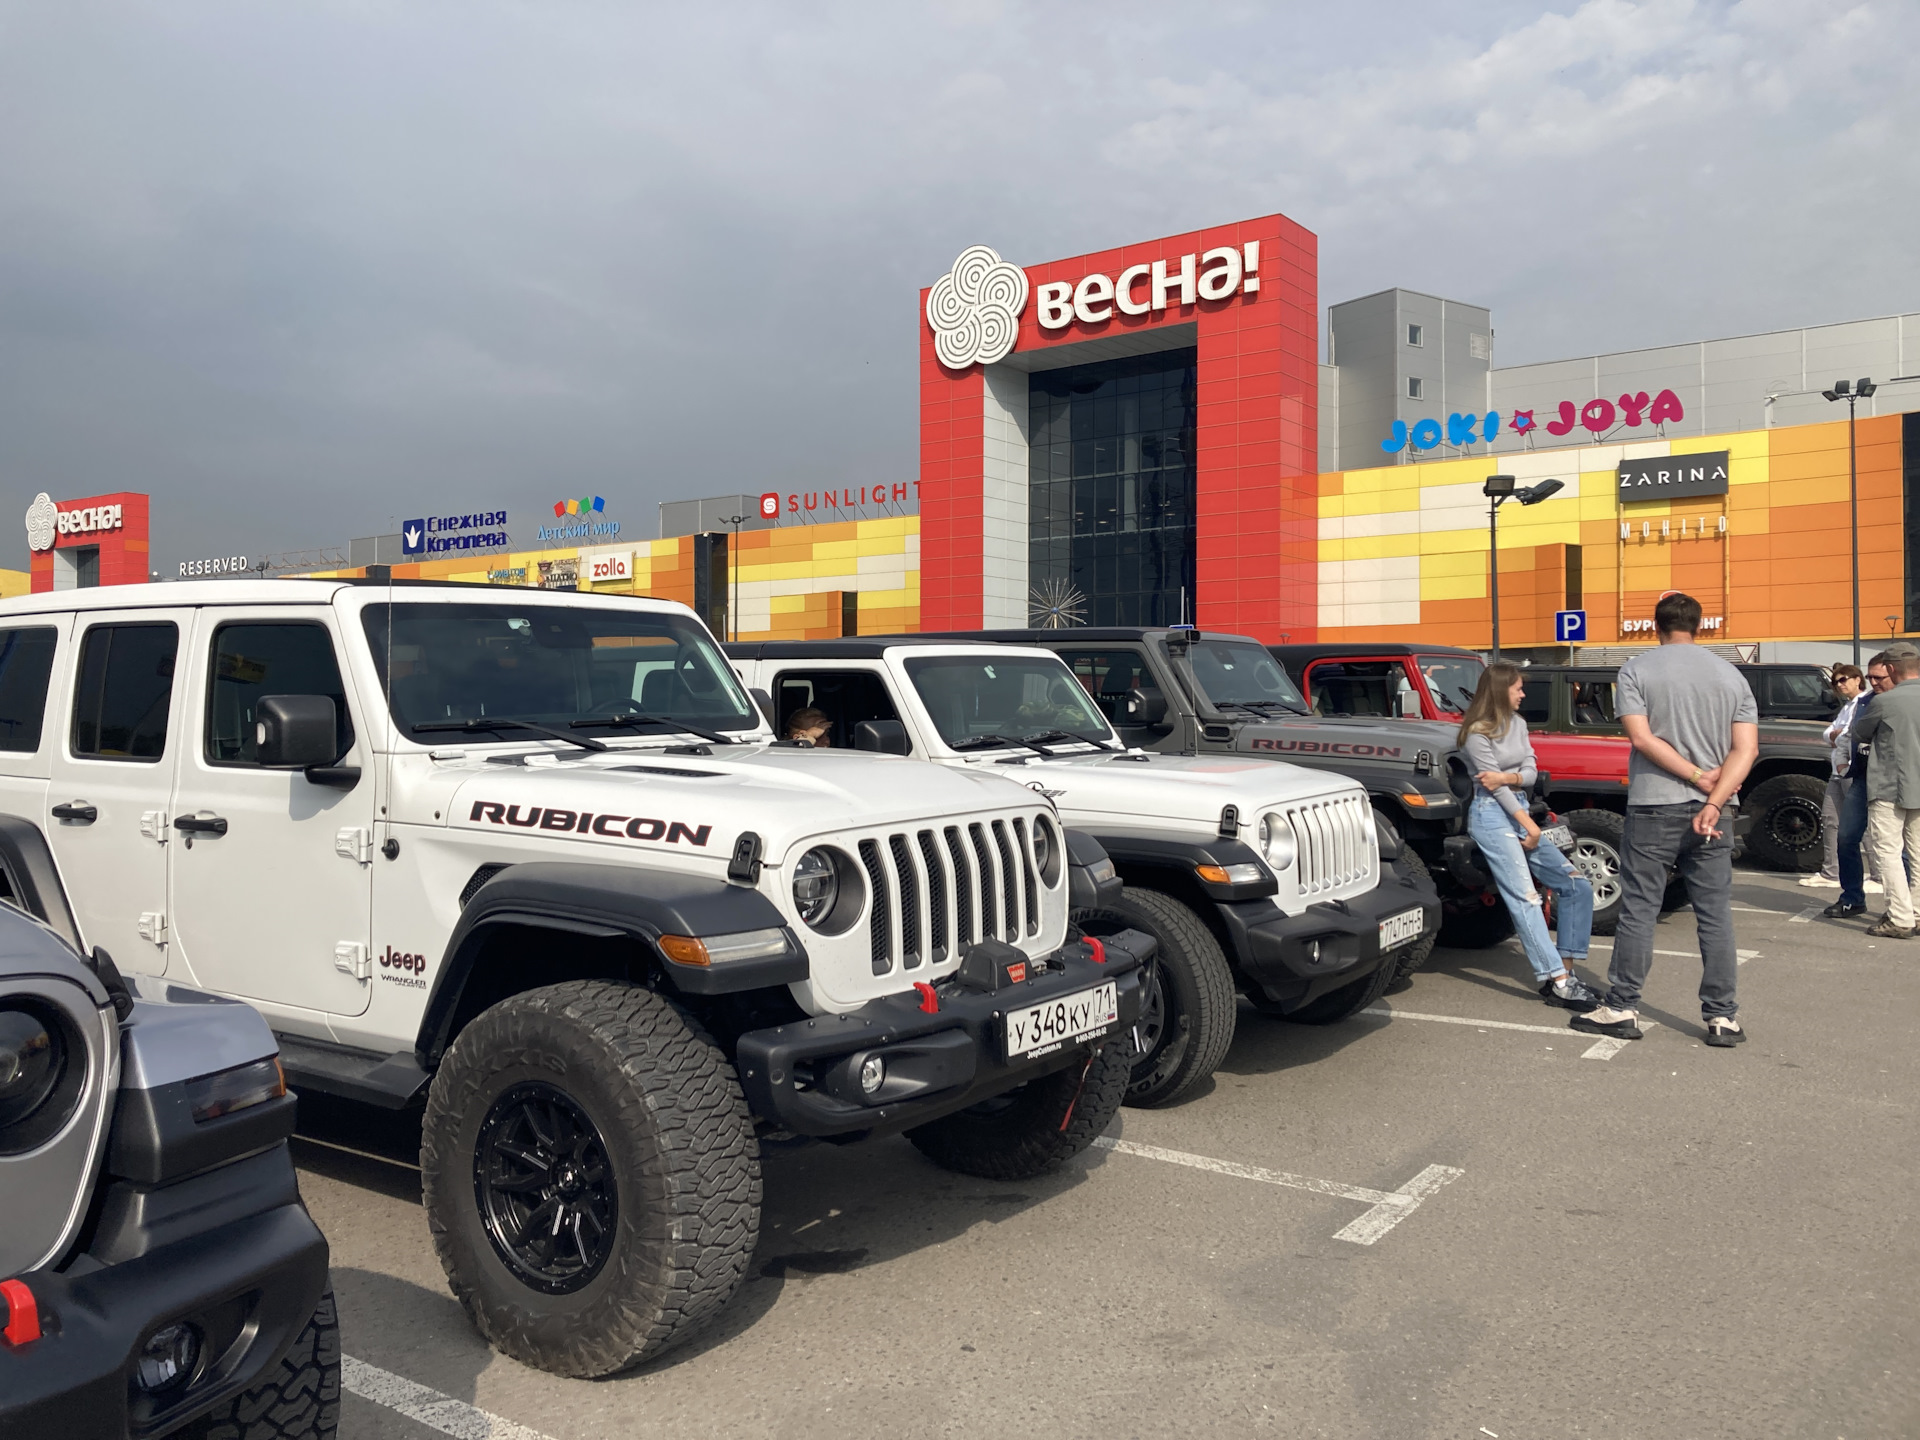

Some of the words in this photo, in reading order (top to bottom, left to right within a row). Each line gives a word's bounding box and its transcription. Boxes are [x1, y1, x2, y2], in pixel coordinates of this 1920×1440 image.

[1381, 410, 1500, 453] JOKI
[1547, 389, 1684, 436] JOYA
[1620, 465, 1726, 488] ZARINA
[427, 510, 507, 532] Снежная
[536, 521, 590, 542] Детский
[593, 521, 620, 539] мир
[1620, 515, 1726, 539] MOHITO
[427, 531, 507, 553] Королева
[179, 555, 248, 576] RESERVED
[593, 557, 625, 577] zolla
[1563, 614, 1581, 639] P
[1252, 739, 1401, 757] RUBICON
[469, 800, 713, 847] RUBICON
[379, 945, 426, 976] Jeep
[381, 974, 427, 986] WRANGLER
[1095, 1011, 1108, 1024] RUS
